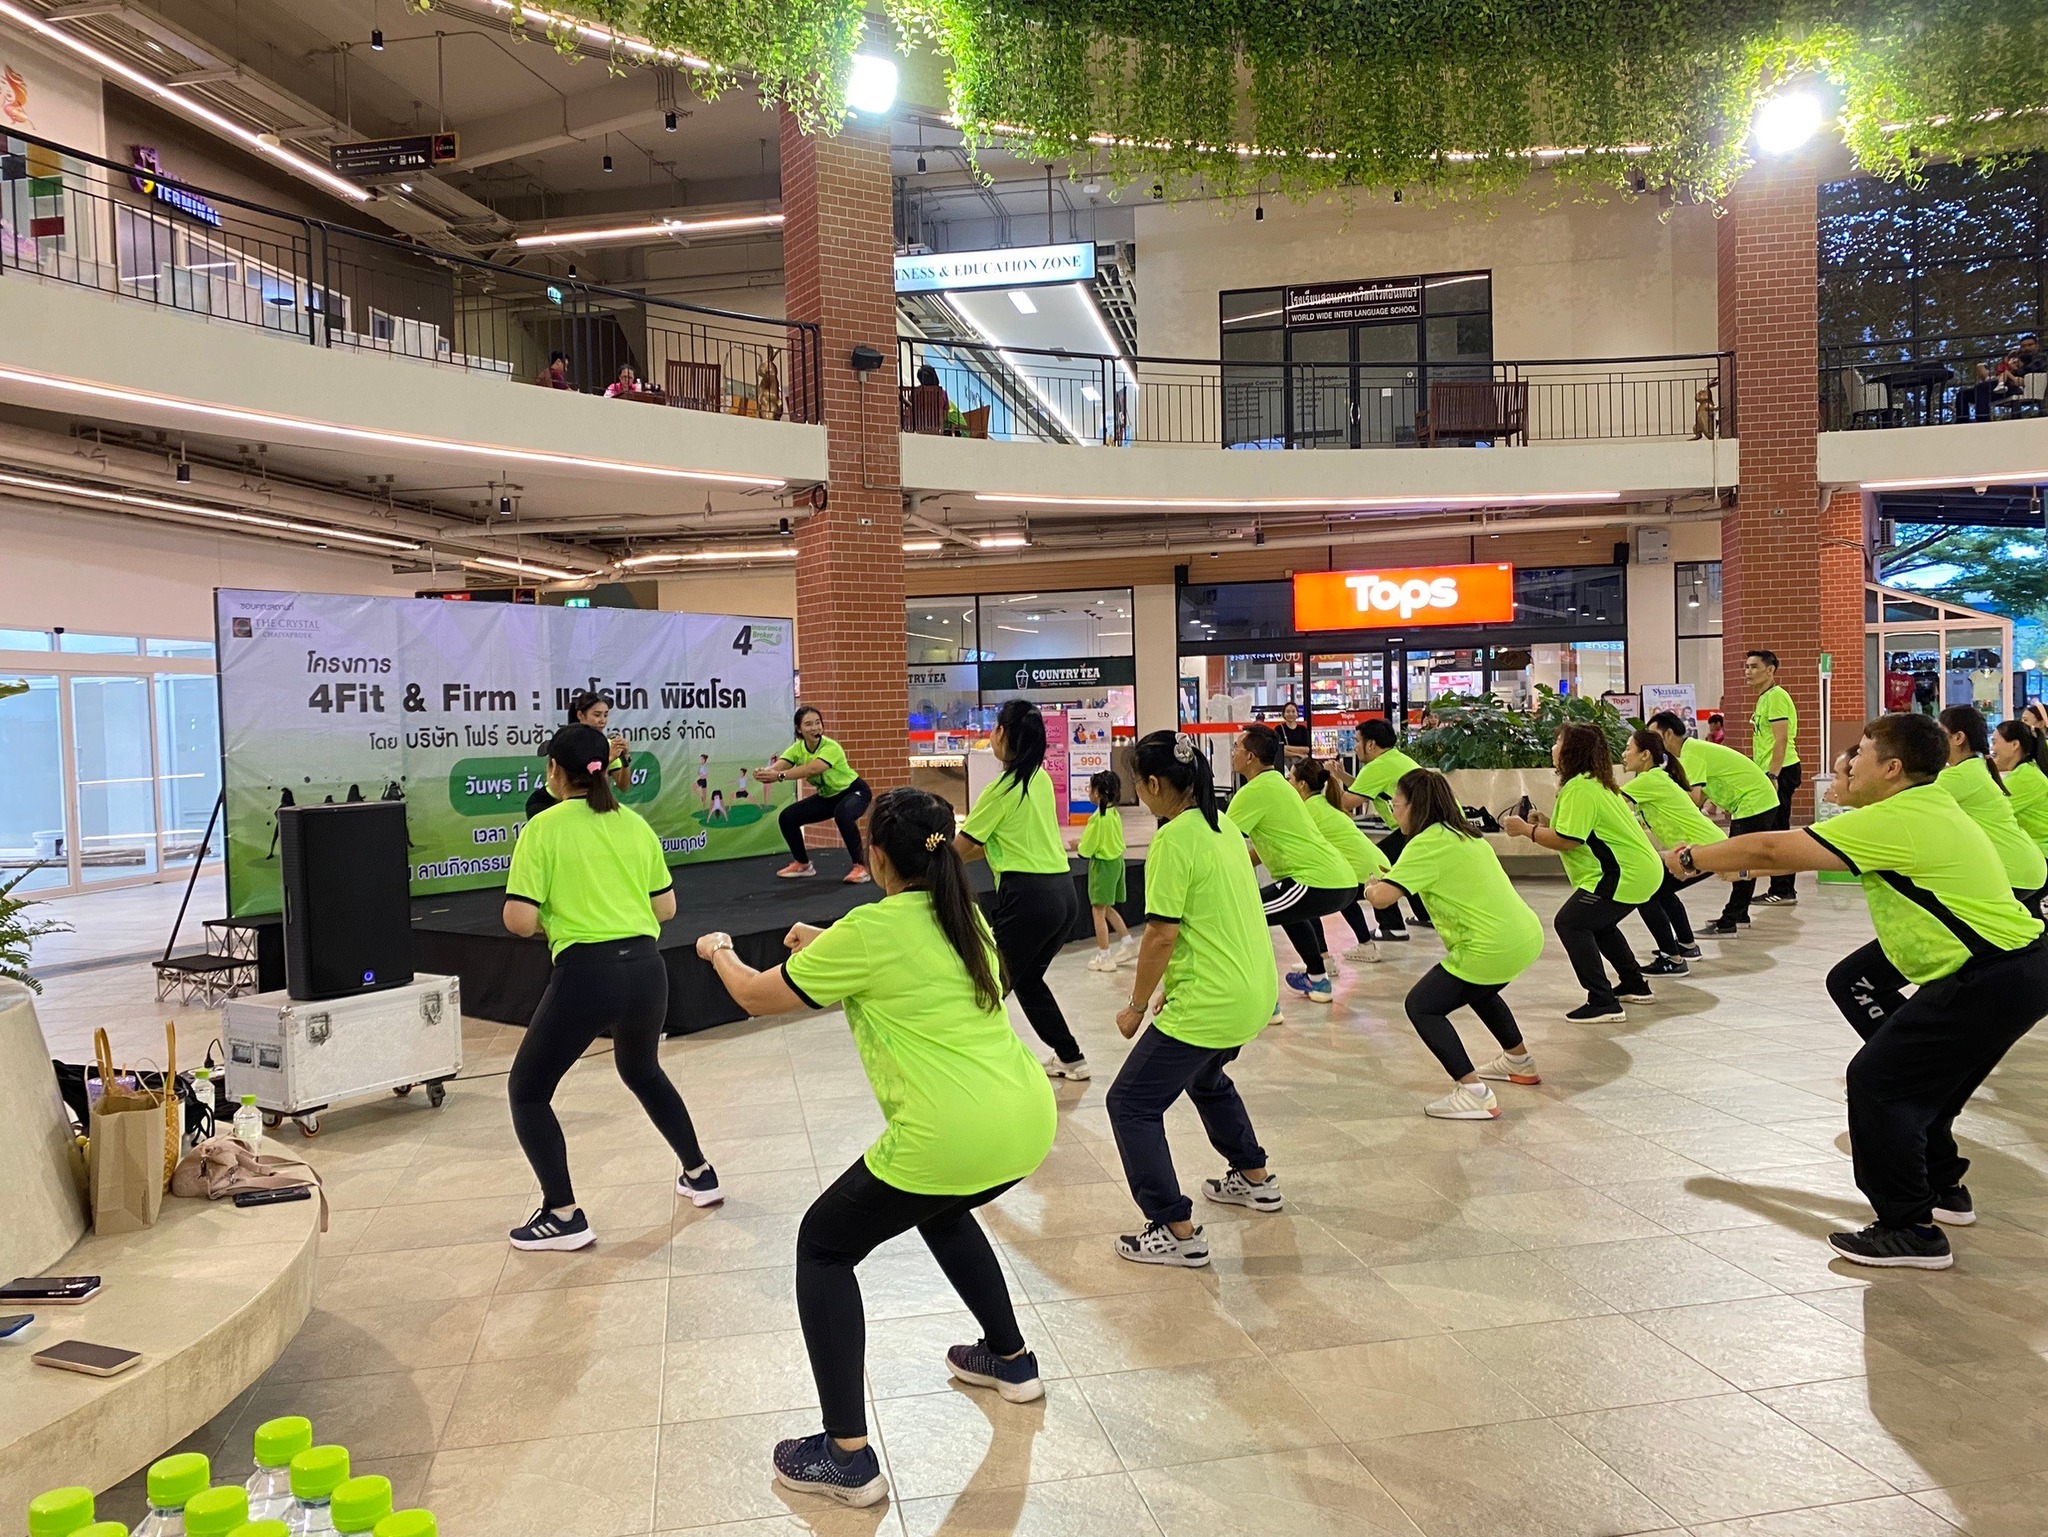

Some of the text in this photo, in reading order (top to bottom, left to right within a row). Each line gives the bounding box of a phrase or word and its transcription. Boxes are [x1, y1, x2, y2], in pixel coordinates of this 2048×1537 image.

[156, 183, 222, 226] TERMINAL
[895, 255, 1082, 281] TNESS & EDUCATION ZONE
[1291, 305, 1417, 322] WORLD WIDE INTER LANGUAGE SCHOOL
[1345, 575, 1459, 619] Tops
[256, 619, 320, 629] THE CRYSTAL
[732, 625, 752, 656] 4
[307, 650, 392, 674] โครงการ
[1032, 667, 1101, 680] COUNTRY TEA
[908, 673, 947, 683] TRY TEA
[308, 683, 385, 713] 4Fit
[403, 683, 427, 713] &
[443, 683, 516, 712] Firm
[661, 678, 747, 709] พิชิตโรค
[1612, 698, 1630, 706] Tops
[369, 732, 398, 750] โดย
[405, 726, 459, 748] บริษัท
[464, 724, 499, 747] โฟร์
[677, 719, 715, 740] จำกัด
[929, 760, 964, 768] SERVICE
[1080, 757, 1102, 766] 990
[465, 775, 512, 800] วันพุธ
[518, 766, 529, 792] ที่
[473, 827, 506, 844] เวลา
[1850, 976, 1885, 1020] DKY
